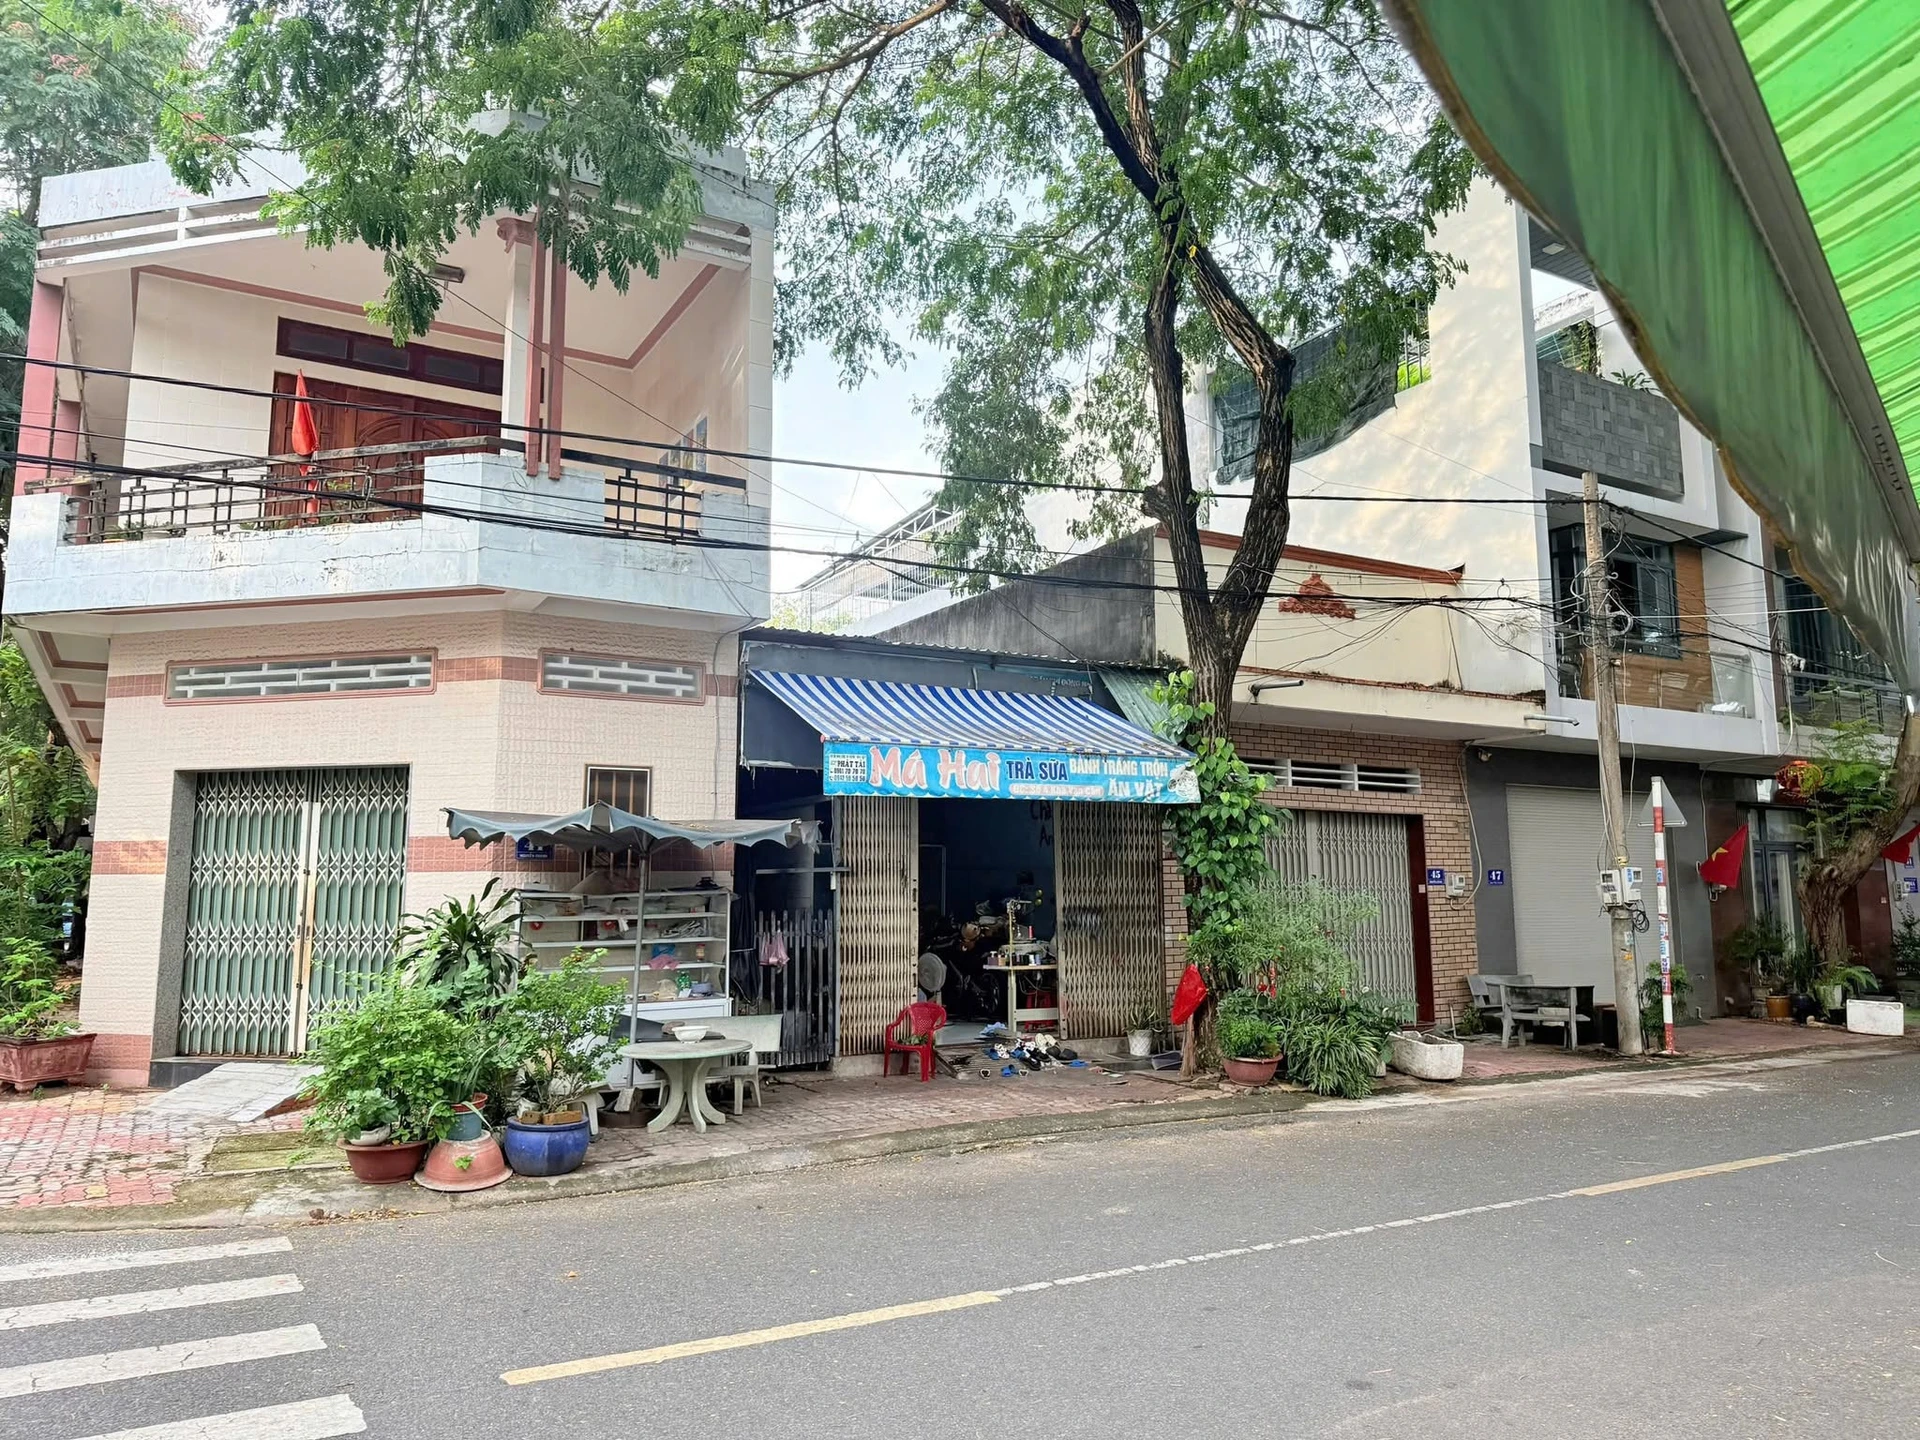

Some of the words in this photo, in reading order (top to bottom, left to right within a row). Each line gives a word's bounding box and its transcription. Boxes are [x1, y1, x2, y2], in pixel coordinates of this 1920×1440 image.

[869, 746, 928, 789] Má
[938, 749, 1000, 791] Hai
[1006, 757, 1035, 779] TRÀ
[1039, 759, 1068, 781] SỮA
[1108, 778, 1131, 797] ĂN
[1430, 870, 1441, 879] 45
[1489, 870, 1501, 880] 47
